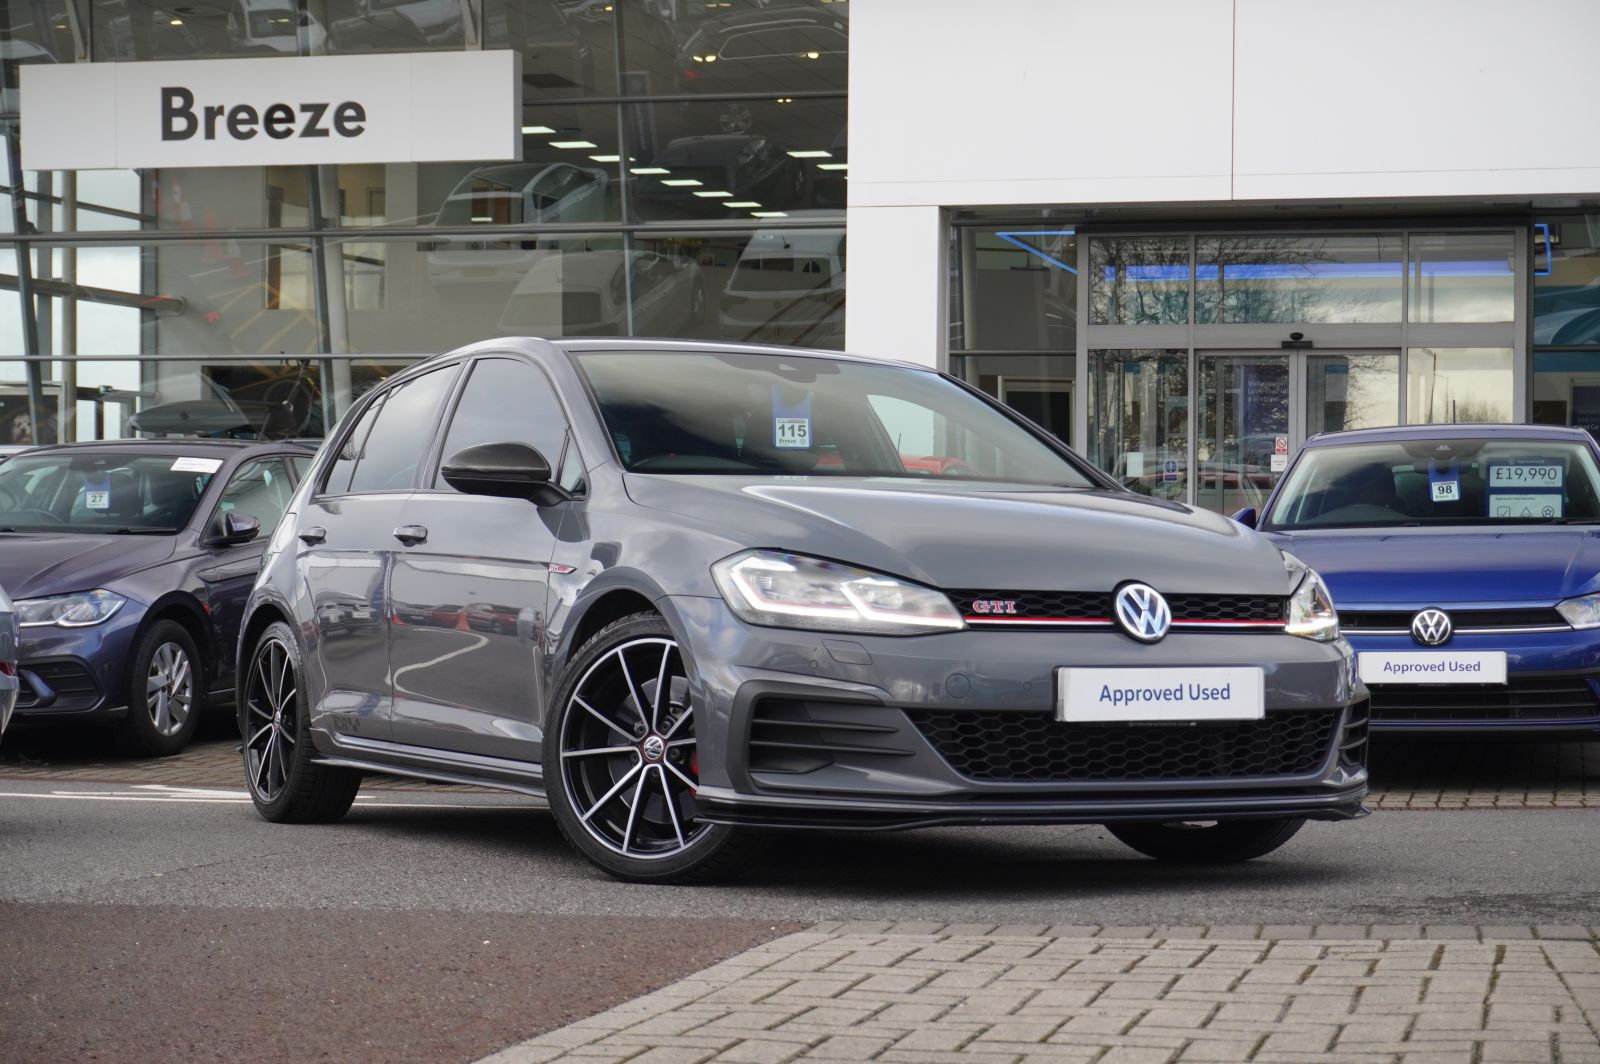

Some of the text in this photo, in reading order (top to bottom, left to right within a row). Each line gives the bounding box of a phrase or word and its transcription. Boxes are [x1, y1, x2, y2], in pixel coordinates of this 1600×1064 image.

[160, 86, 366, 141] Breeze
[778, 424, 807, 437] 115
[1495, 467, 1557, 482] £19,990
[1438, 485, 1453, 495] 98
[91, 495, 104, 503] 27
[972, 600, 1017, 613] GTI
[1383, 661, 1481, 674] Approved Used
[1100, 683, 1231, 706] Approved Used
